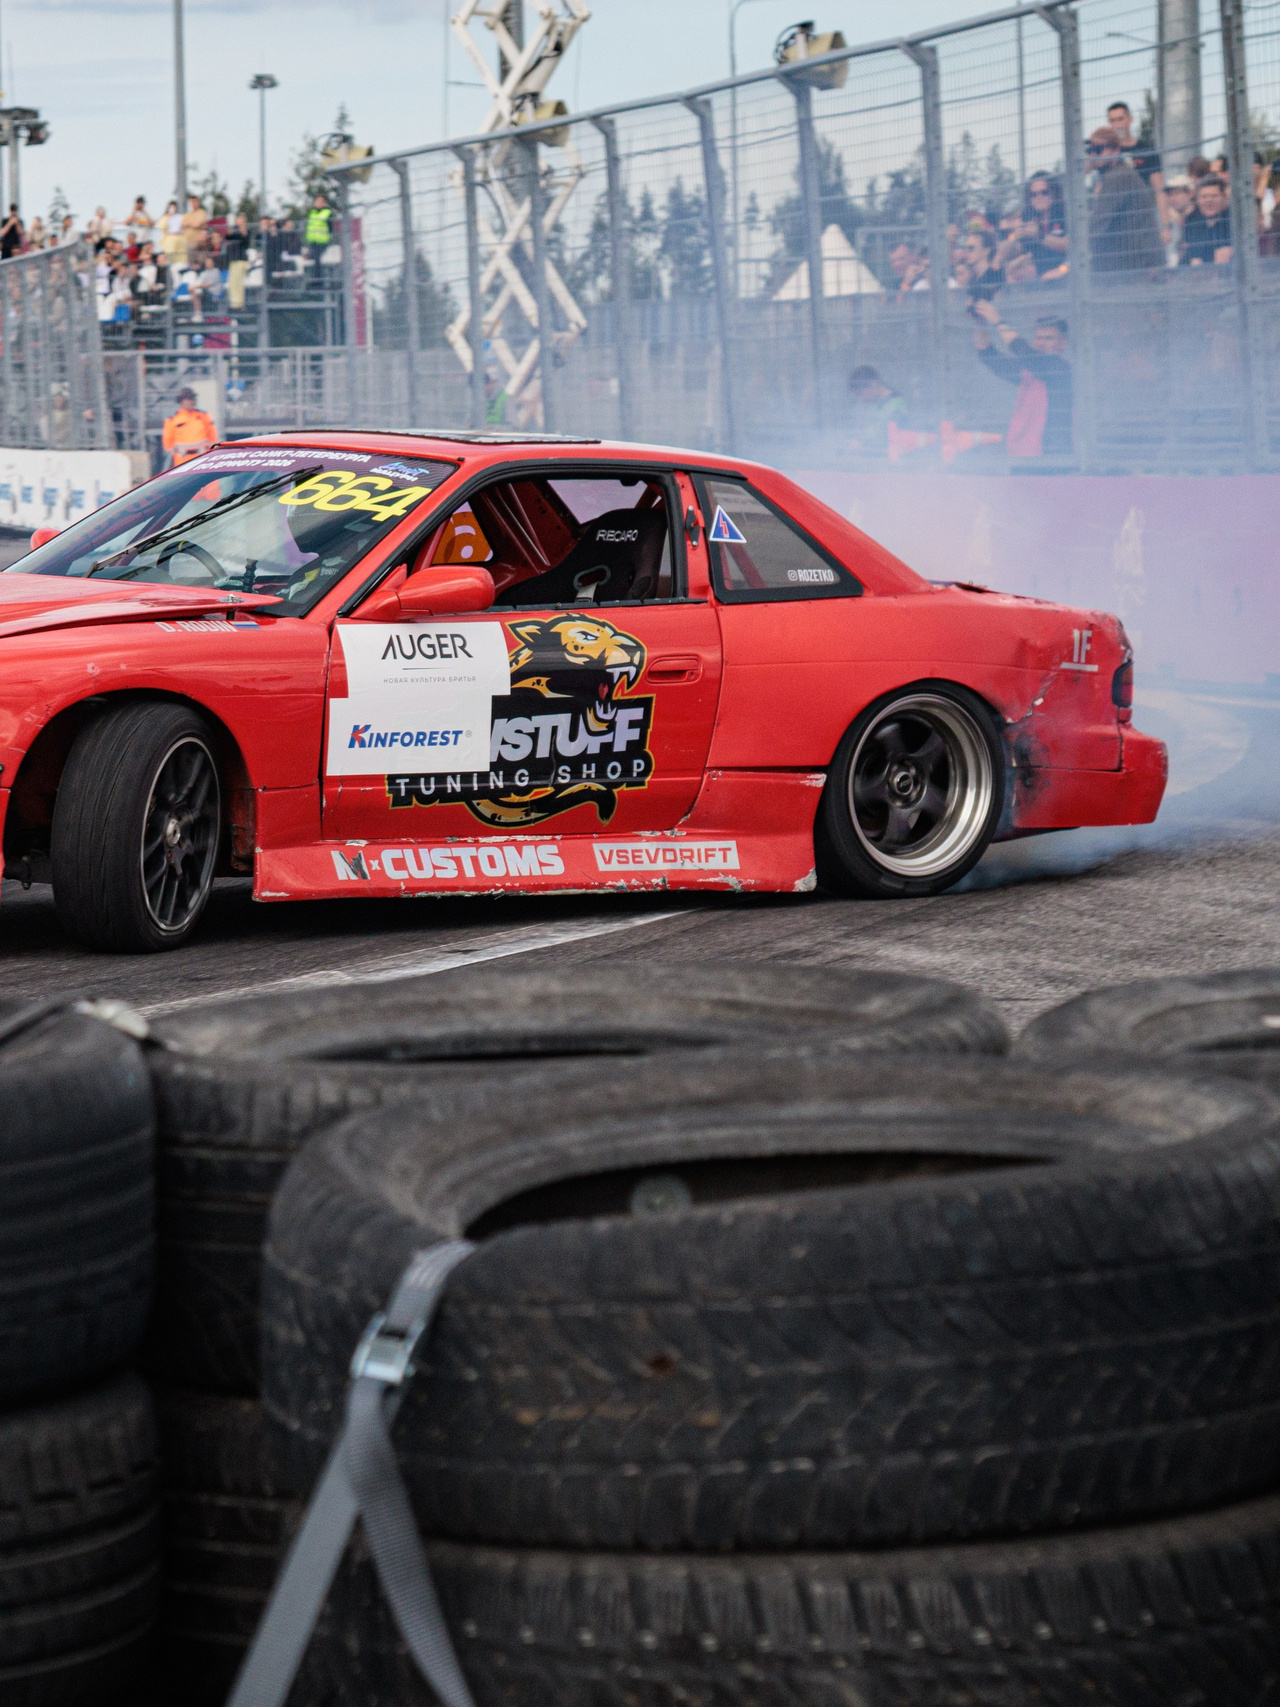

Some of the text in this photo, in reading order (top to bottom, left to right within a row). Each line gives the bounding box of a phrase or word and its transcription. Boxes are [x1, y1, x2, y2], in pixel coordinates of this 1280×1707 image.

[278, 470, 433, 522] 664
[596, 529, 639, 542] RECARO
[797, 569, 835, 582] ROZETKO
[176, 620, 238, 633] RODIN
[381, 633, 474, 660] AUGER
[410, 676, 447, 684] КУЛЬТУРА
[448, 675, 477, 683] БРИТЬЯ
[348, 724, 464, 749] KINFOREST
[395, 758, 646, 797] TUNING SHOP
[598, 847, 733, 866] VSEVDRIFT
